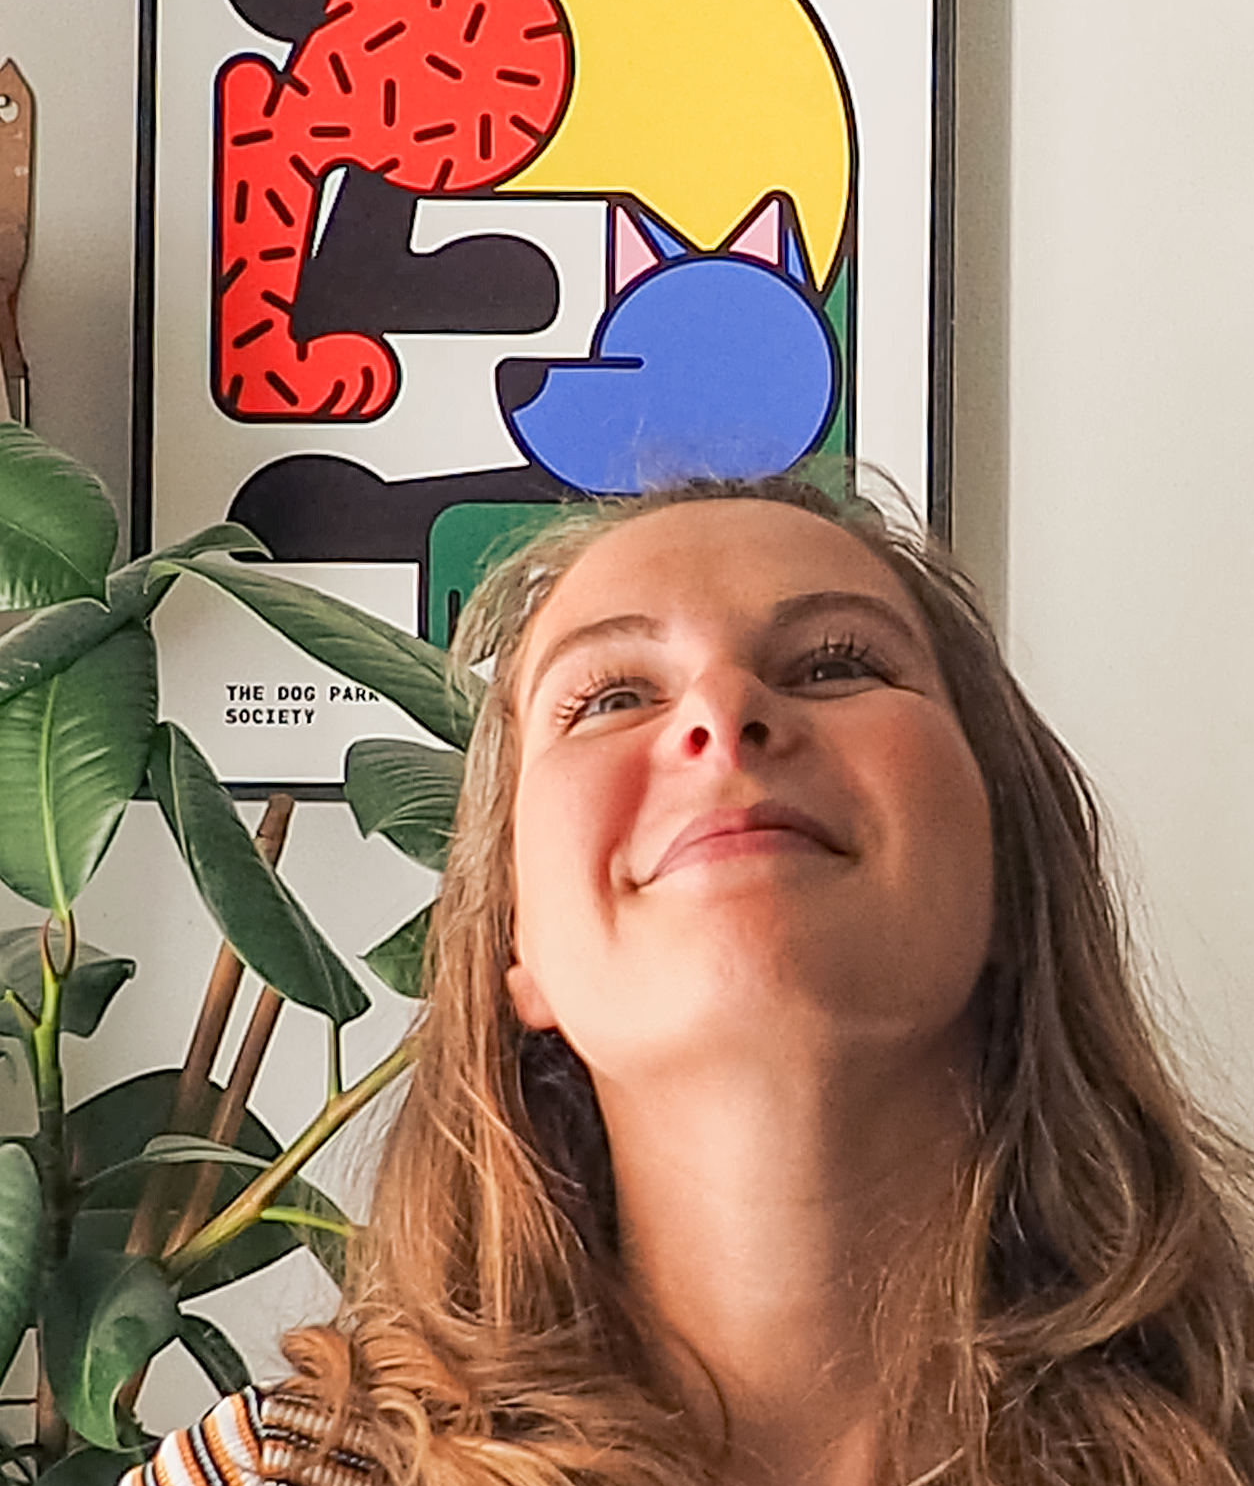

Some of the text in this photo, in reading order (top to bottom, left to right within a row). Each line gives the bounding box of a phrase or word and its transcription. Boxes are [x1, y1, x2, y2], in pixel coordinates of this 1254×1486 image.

[226, 685, 265, 702] THE
[278, 686, 316, 702] DOG
[225, 708, 315, 725] SOCIETY
